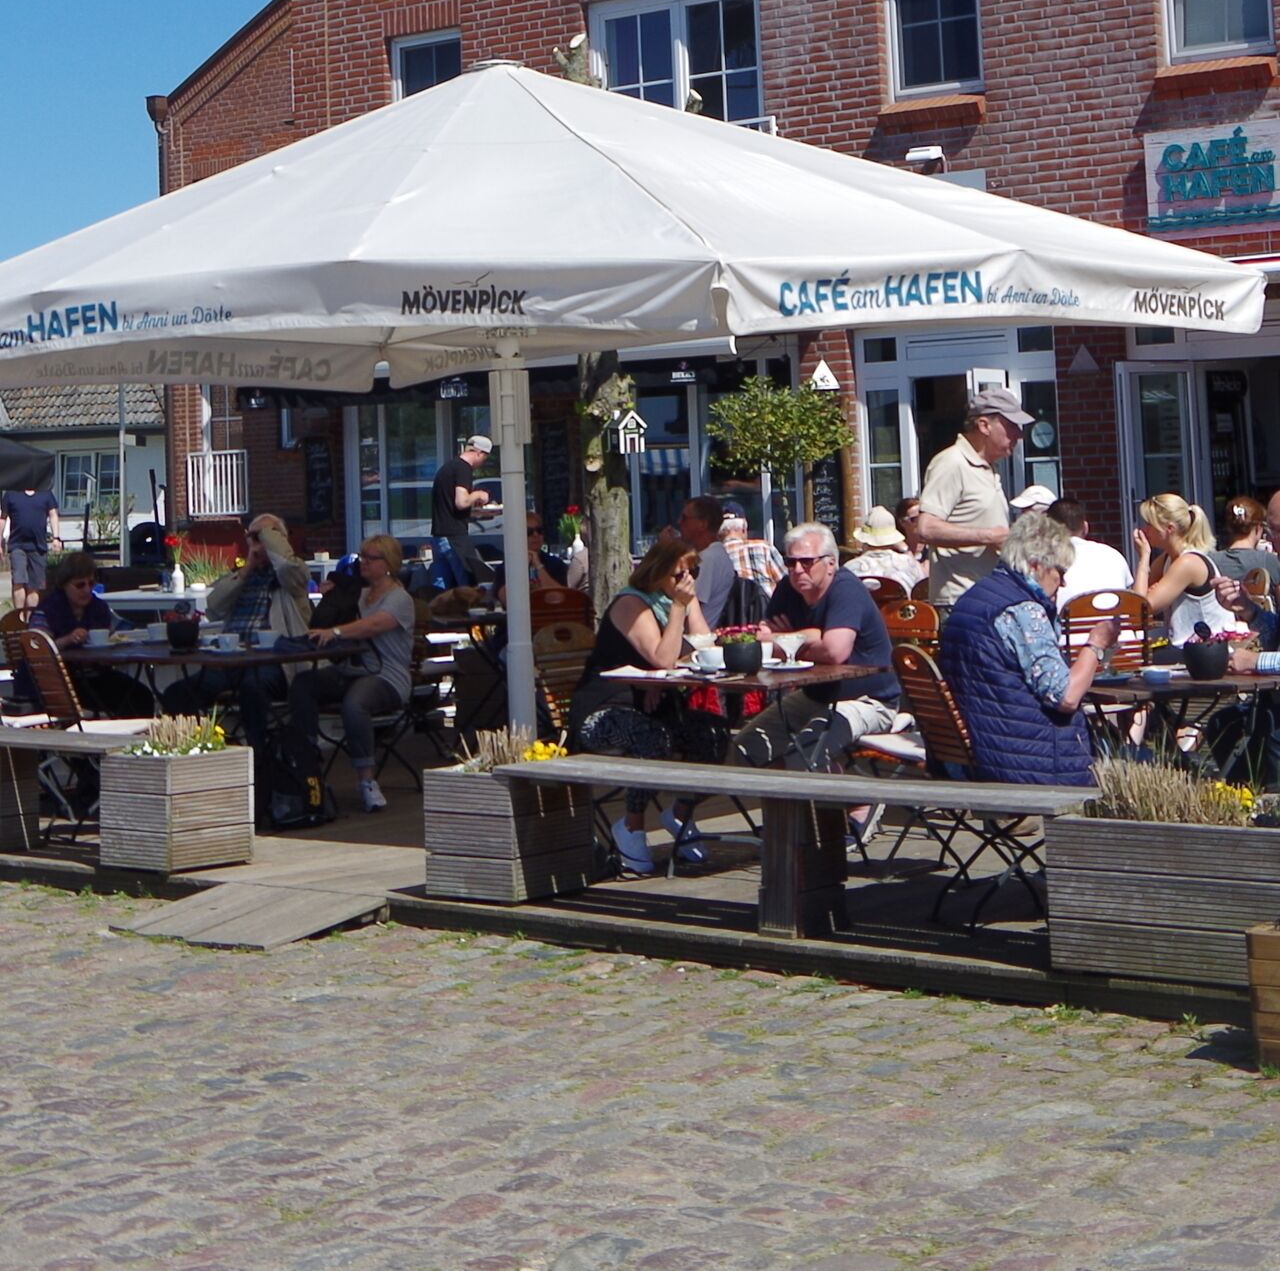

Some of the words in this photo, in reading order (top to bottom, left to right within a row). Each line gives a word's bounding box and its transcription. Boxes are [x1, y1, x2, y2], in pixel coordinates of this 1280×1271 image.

[1161, 125, 1248, 171] CAFÉ
[1162, 163, 1276, 202] HAFEN
[401, 284, 528, 315] MÖVENPICK
[778, 270, 850, 317] CAFÉ
[851, 289, 883, 310] am
[884, 271, 983, 307] HAFEN
[987, 285, 999, 304] bi
[1001, 285, 1032, 304] Anni
[1032, 292, 1048, 304] un
[1134, 287, 1225, 321] MÖVENPICK
[27, 300, 118, 343] HAFEN
[122, 313, 134, 329] bi
[136, 311, 168, 329] Anni
[171, 314, 188, 328] un
[191, 306, 233, 325] Dörte
